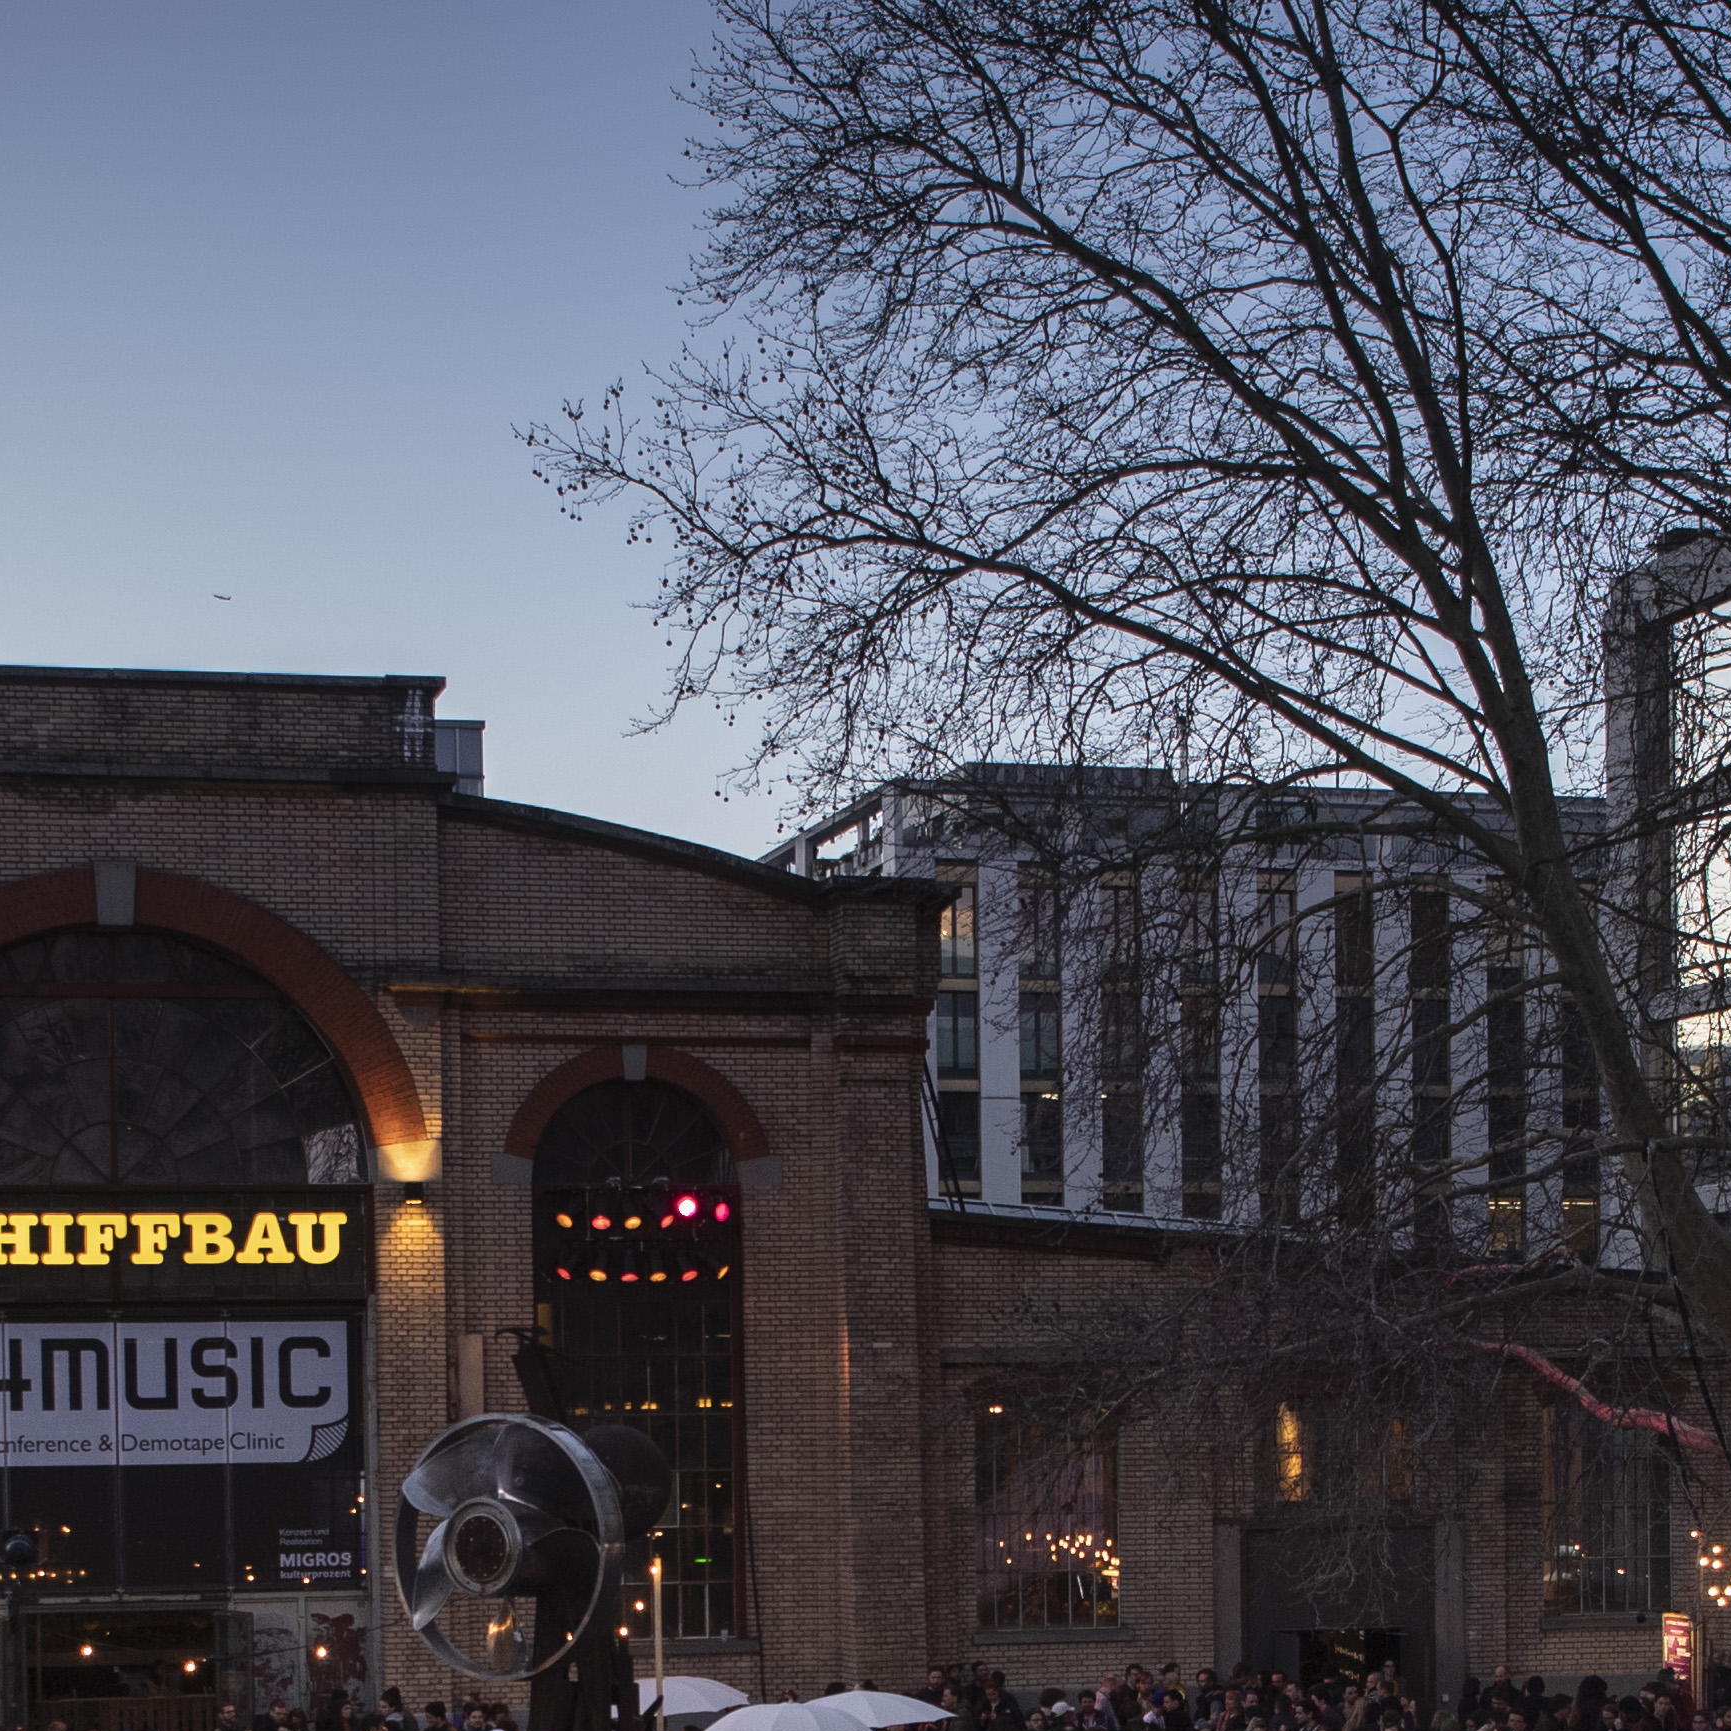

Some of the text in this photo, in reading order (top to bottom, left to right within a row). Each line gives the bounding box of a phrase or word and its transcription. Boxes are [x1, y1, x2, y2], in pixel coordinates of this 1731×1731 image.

[98, 1434, 113, 1452] &
[122, 1432, 225, 1456] Demotape
[230, 1431, 285, 1451] Clinic
[279, 1551, 352, 1568] MIGROS
[280, 1569, 352, 1580] kulturprozent
